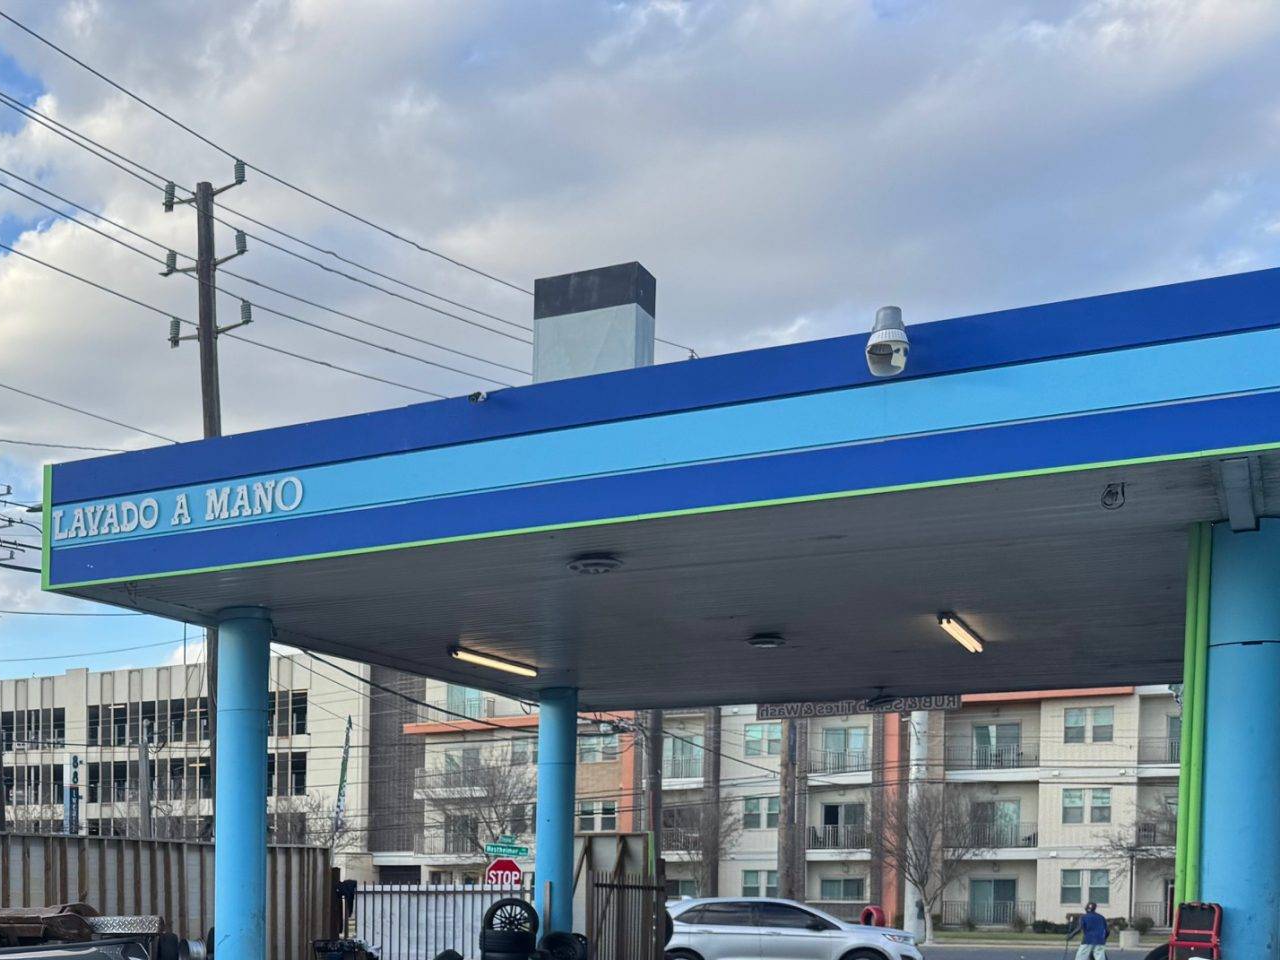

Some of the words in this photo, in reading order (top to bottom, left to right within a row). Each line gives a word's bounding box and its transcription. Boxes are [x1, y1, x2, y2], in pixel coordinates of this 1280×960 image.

[53, 497, 160, 541] LAVADO
[170, 492, 193, 526] A
[205, 475, 304, 522] MANO
[488, 870, 520, 885] STOP
